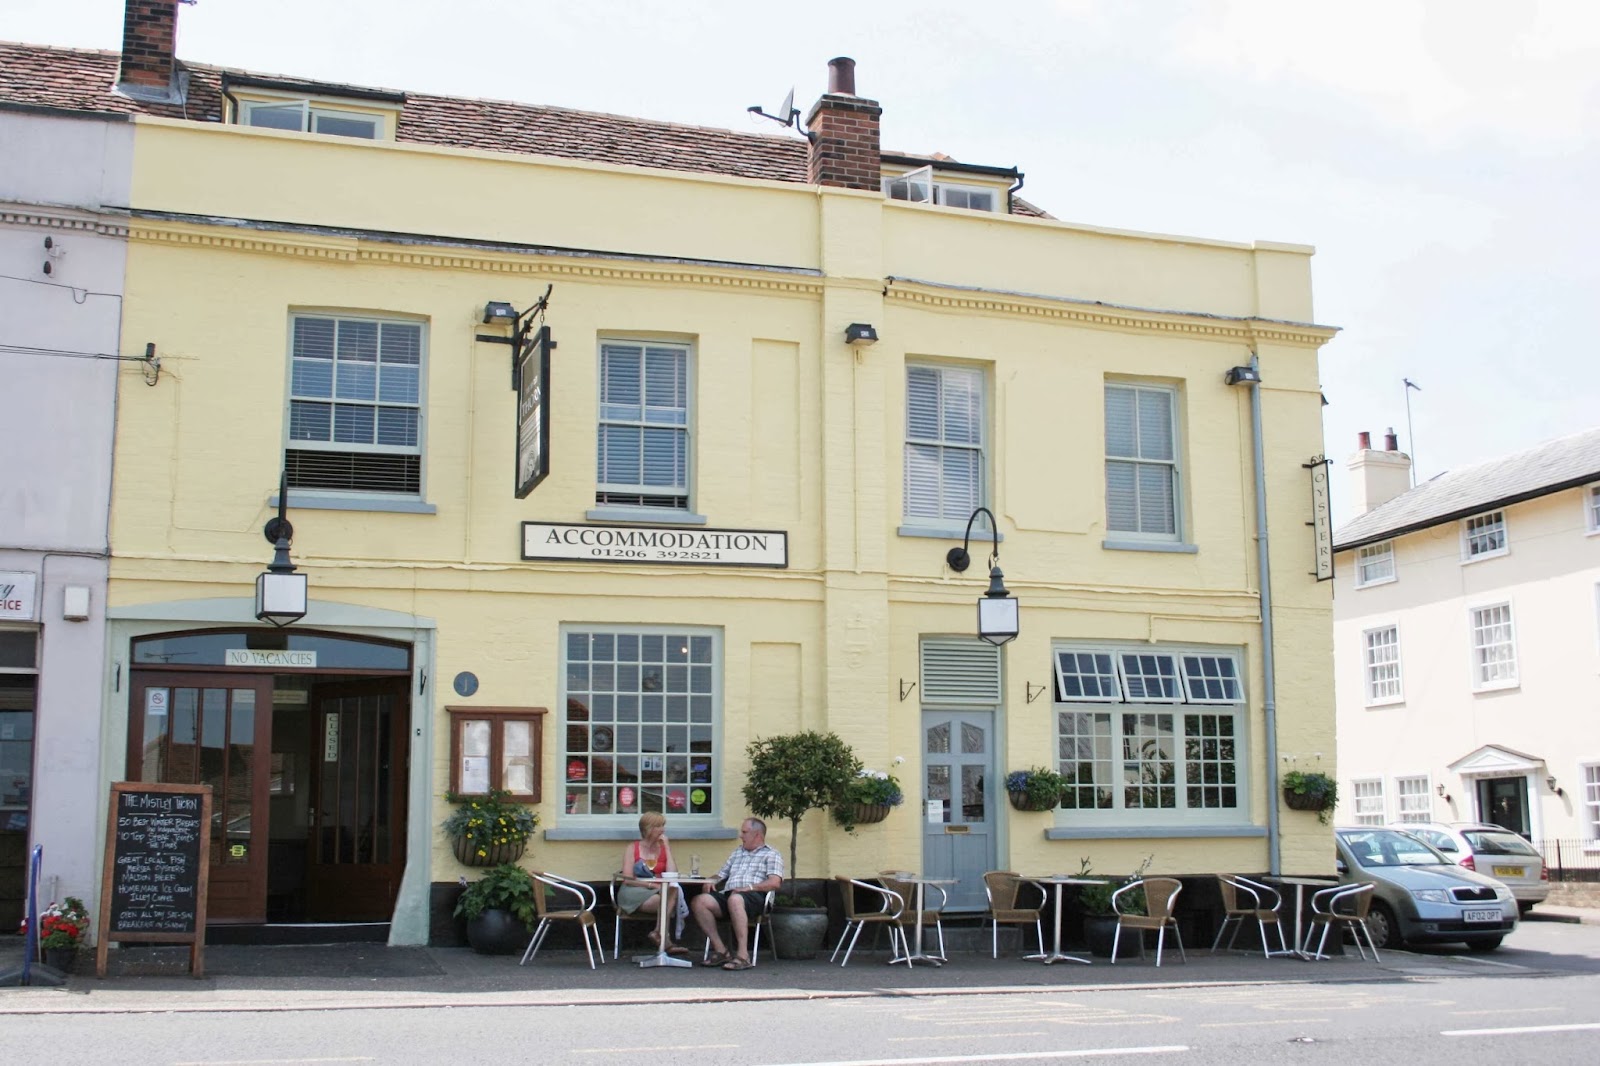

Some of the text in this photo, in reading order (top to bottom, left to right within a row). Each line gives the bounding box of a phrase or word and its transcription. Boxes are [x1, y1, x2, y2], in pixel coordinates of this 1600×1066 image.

[1315, 473, 1328, 570] OYSTERS
[545, 528, 768, 551] ACCOMMODATION
[591, 548, 721, 560] 01206 392821
[231, 652, 312, 665] NO VACANCIES
[328, 716, 338, 758] CLOSED
[121, 793, 197, 813] THE MISTLEY THORN
[170, 856, 186, 865] FISH
[1467, 911, 1486, 920] AF02
